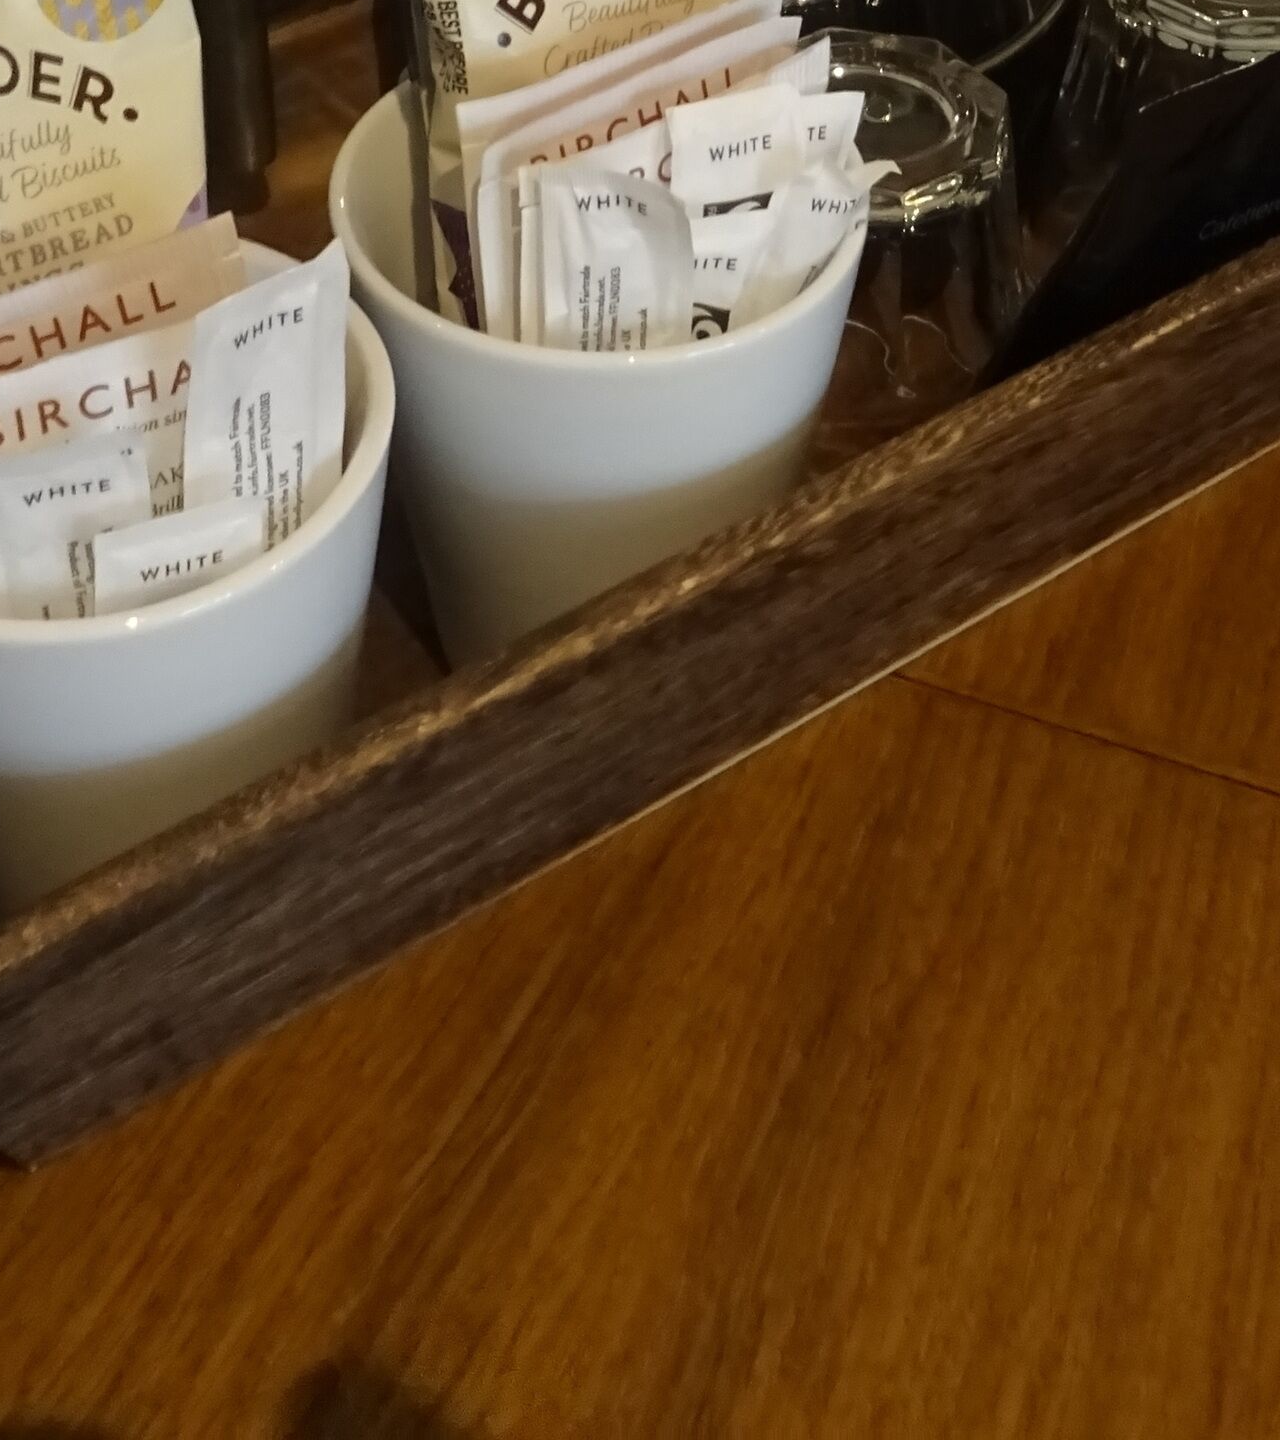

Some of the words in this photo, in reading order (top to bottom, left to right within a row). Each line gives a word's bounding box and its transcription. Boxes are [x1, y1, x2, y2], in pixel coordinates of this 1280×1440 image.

[708, 134, 773, 162] WHITE
[11, 147, 122, 203] Biscuits
[0, 222, 17, 244] &
[22, 192, 117, 239] BUTTERY
[577, 195, 649, 216] WHITE
[232, 306, 306, 350] WHITE
[23, 478, 111, 507] WHITE
[140, 551, 224, 583] WHITE
